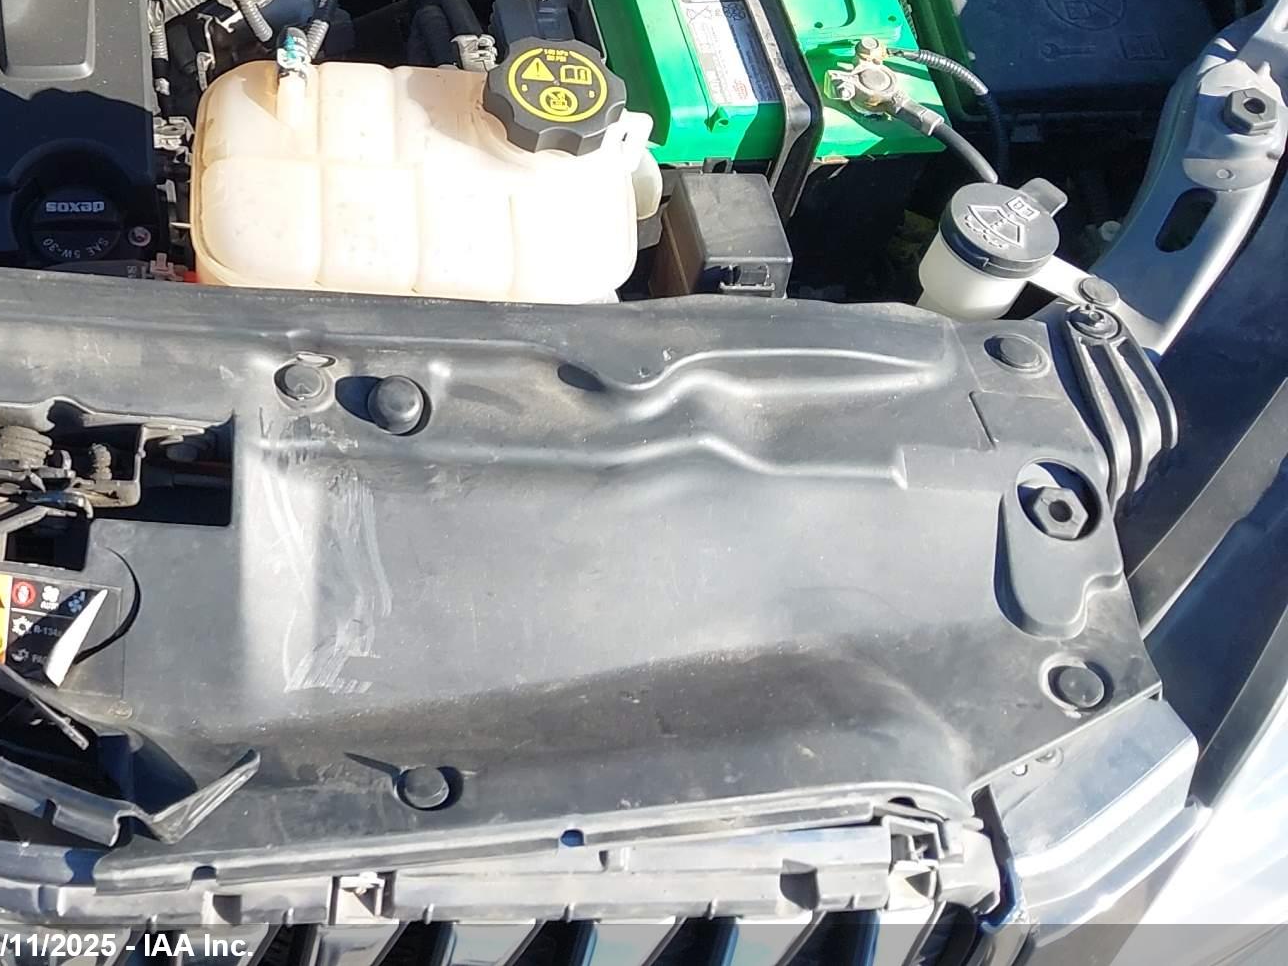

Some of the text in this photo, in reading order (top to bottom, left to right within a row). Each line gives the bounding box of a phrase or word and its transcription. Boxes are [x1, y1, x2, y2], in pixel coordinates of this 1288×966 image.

[45, 201, 105, 213] dexos
[43, 237, 109, 259] SAE 5W-30
